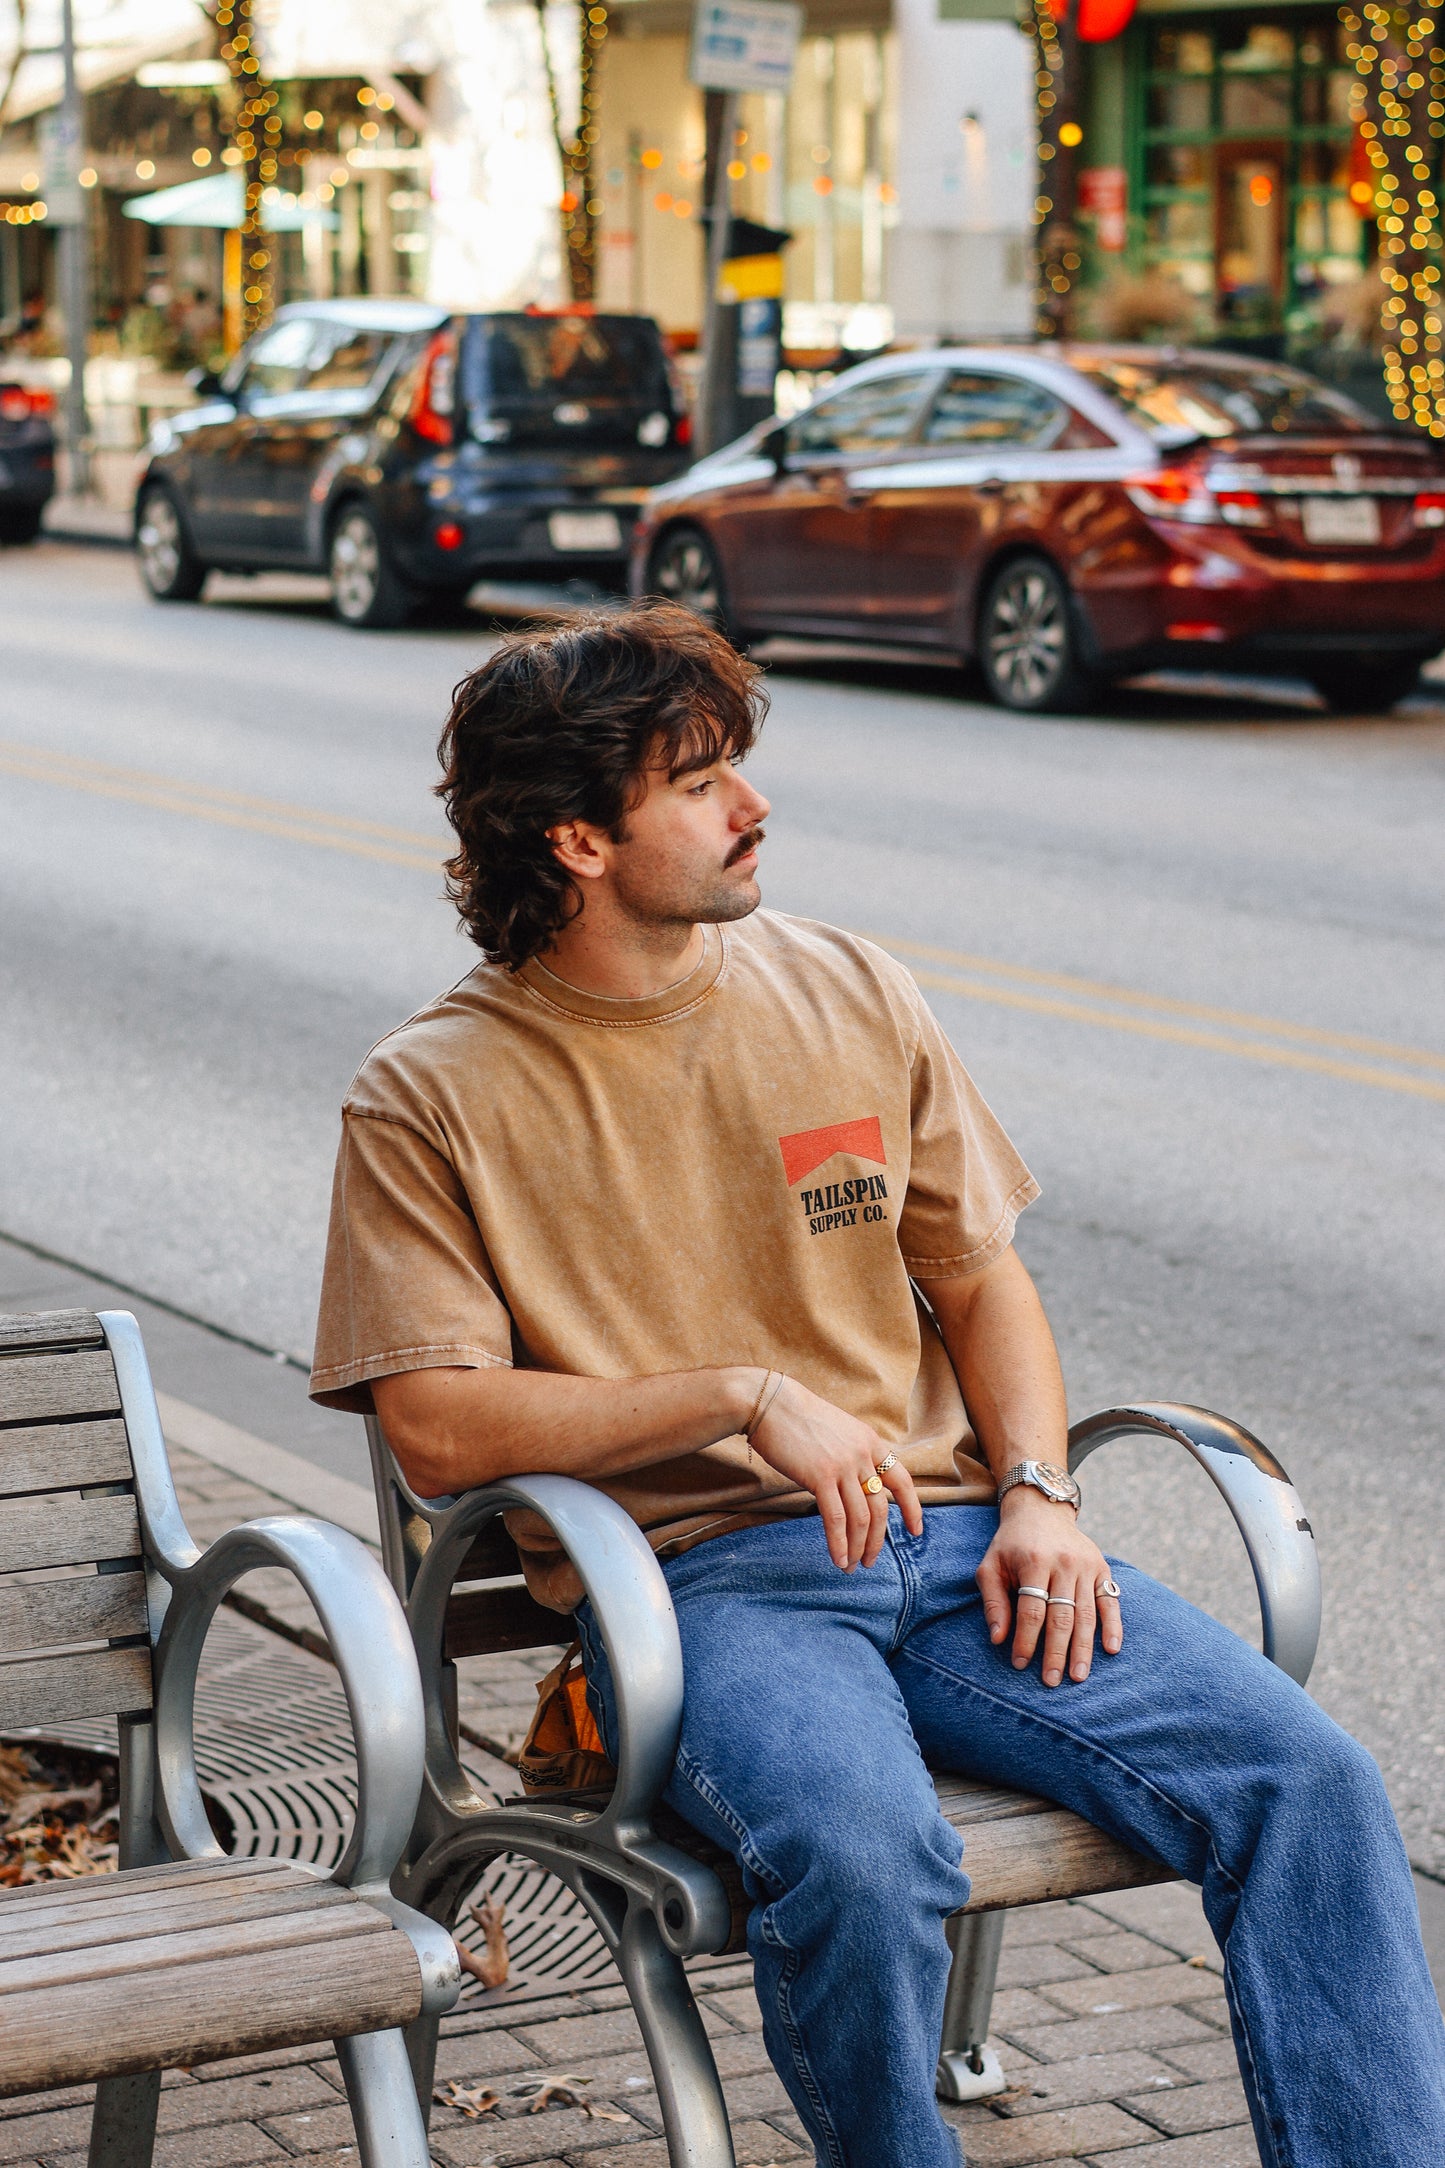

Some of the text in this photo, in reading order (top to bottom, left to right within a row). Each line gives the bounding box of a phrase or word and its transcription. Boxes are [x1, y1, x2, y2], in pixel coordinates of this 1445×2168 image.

[801, 1174, 888, 1216] TAILSPIN
[809, 1204, 887, 1236] SUPPLY CO.
